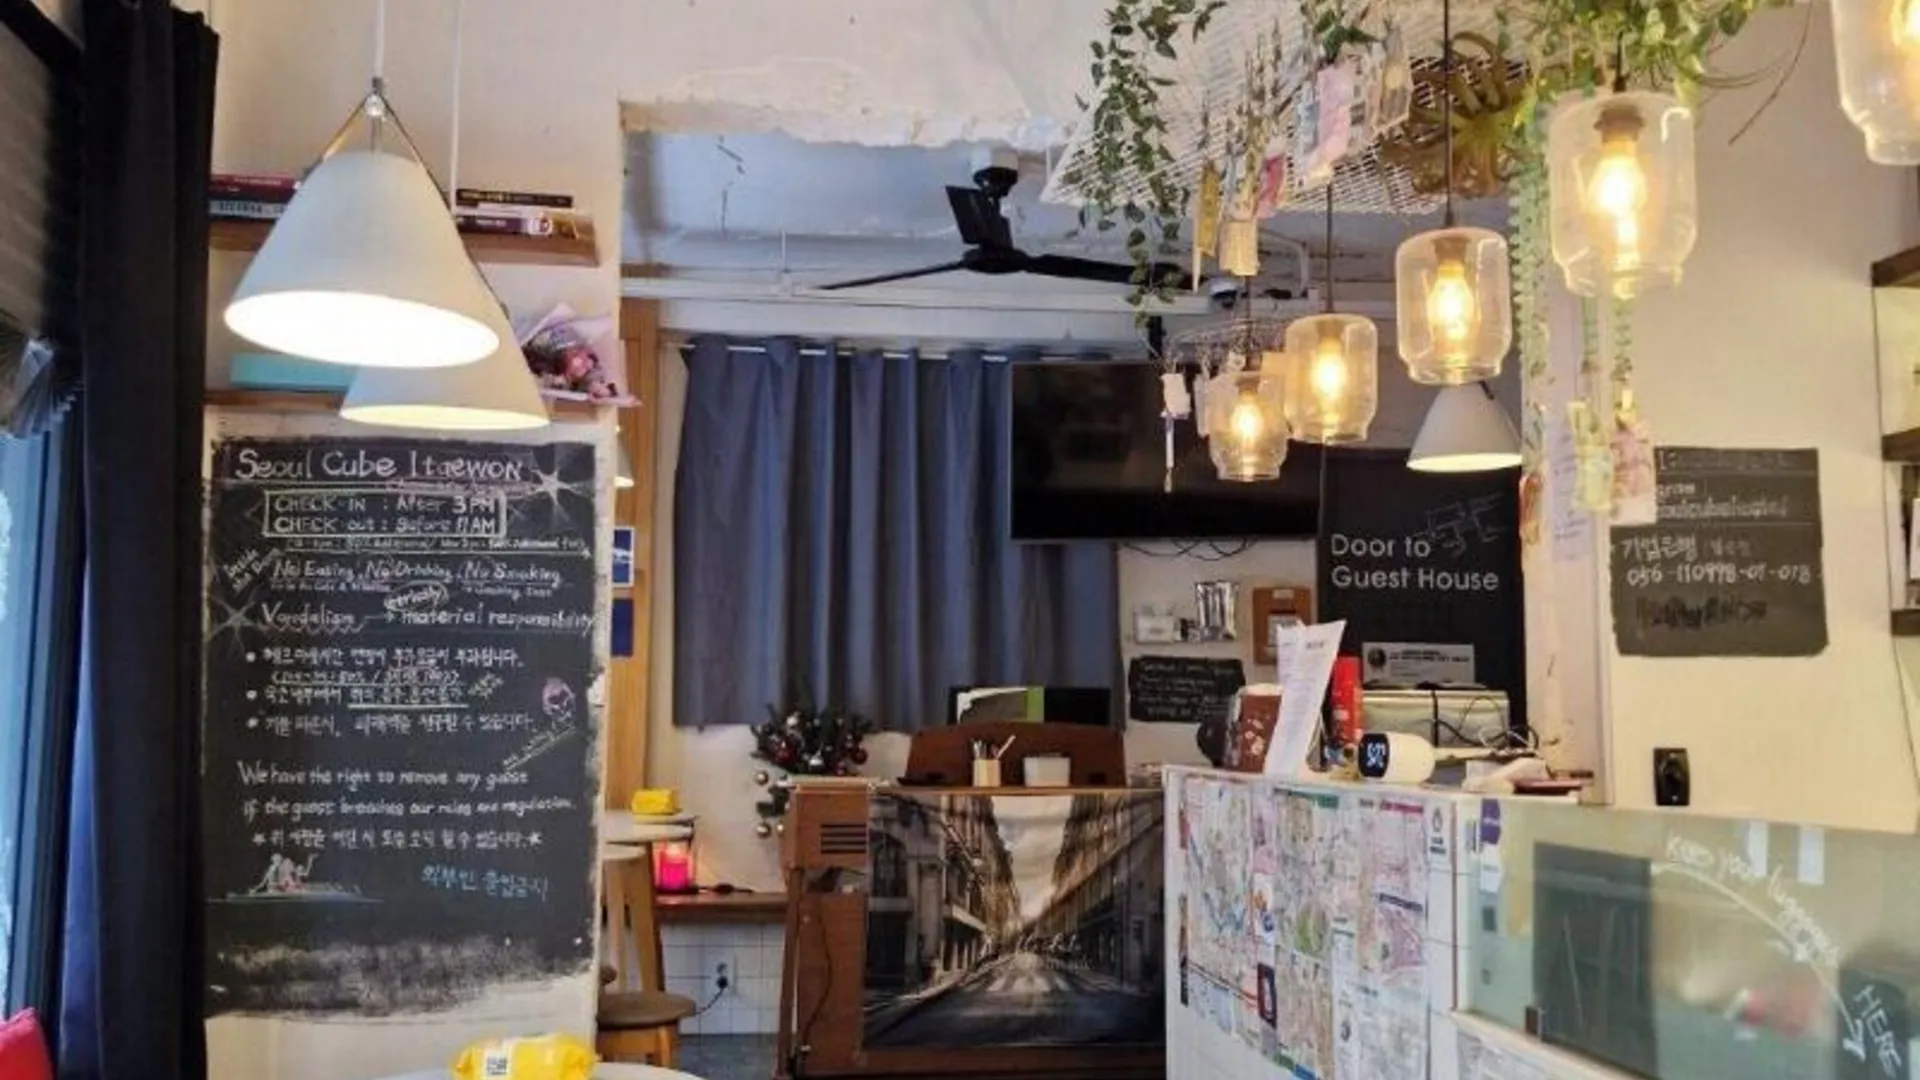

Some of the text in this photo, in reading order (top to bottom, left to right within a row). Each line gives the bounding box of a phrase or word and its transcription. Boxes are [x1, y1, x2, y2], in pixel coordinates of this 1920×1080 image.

[235, 448, 312, 479] Seoul
[322, 450, 397, 478] Cube
[273, 516, 338, 533] CHECK
[1331, 534, 1431, 557] Door to
[1331, 565, 1499, 591] Guest House
[401, 603, 483, 625] material
[237, 760, 268, 785] We
[309, 765, 332, 785] the
[337, 767, 371, 792] right
[456, 772, 481, 792] any
[1853, 985, 1902, 1079] HERE
